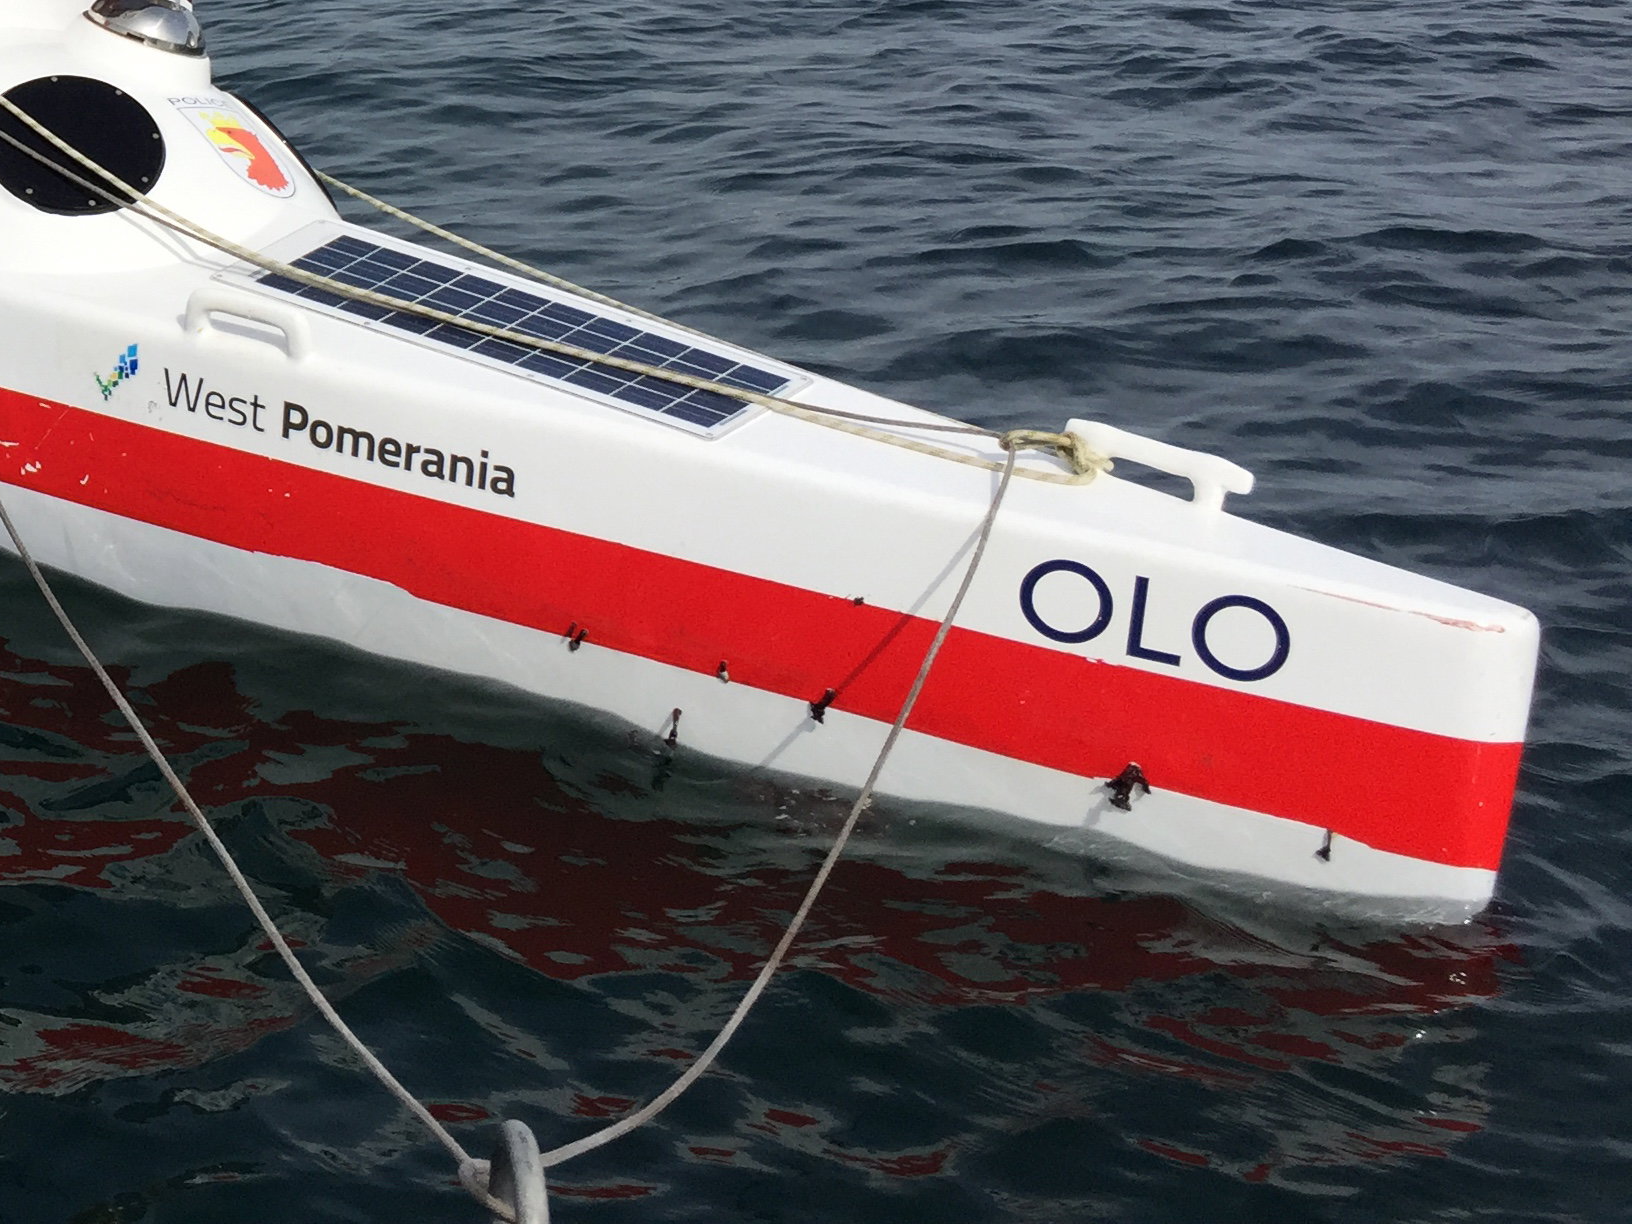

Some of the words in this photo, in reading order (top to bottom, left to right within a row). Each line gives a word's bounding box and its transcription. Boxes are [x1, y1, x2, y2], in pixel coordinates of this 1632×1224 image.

[164, 367, 266, 432] West
[282, 401, 515, 497] Pomerania
[1019, 559, 1290, 681] OLO
